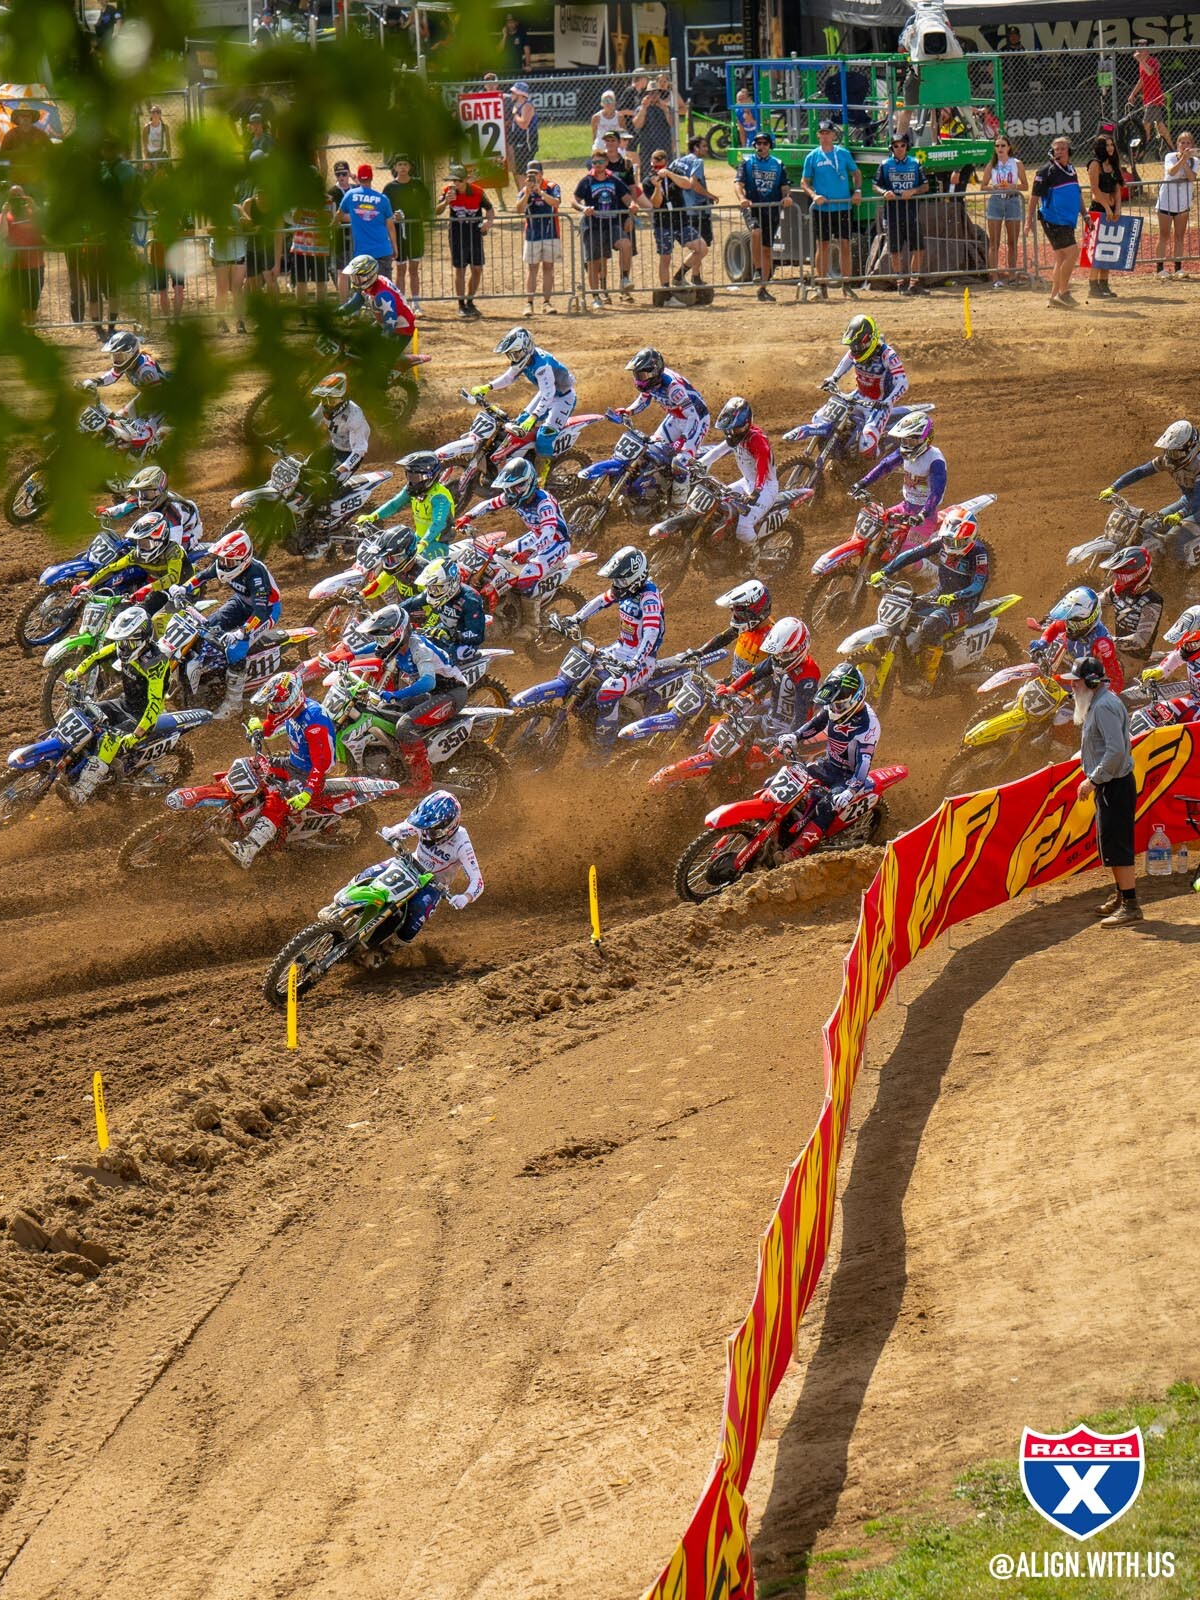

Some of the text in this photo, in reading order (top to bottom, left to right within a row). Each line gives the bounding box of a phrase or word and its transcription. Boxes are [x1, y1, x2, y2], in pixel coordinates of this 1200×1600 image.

[461, 101, 502, 121] GATE
[464, 122, 501, 160] 12
[352, 194, 381, 204] STAFF
[470, 415, 495, 438] 412
[553, 433, 572, 454] 412
[617, 436, 641, 459] 93
[164, 621, 193, 649] 411
[145, 694, 162, 724] FOX
[60, 712, 90, 745] 434
[437, 726, 469, 755] 350
[308, 768, 321, 788] FLY
[771, 775, 800, 802] 23
[846, 800, 868, 819] 23
